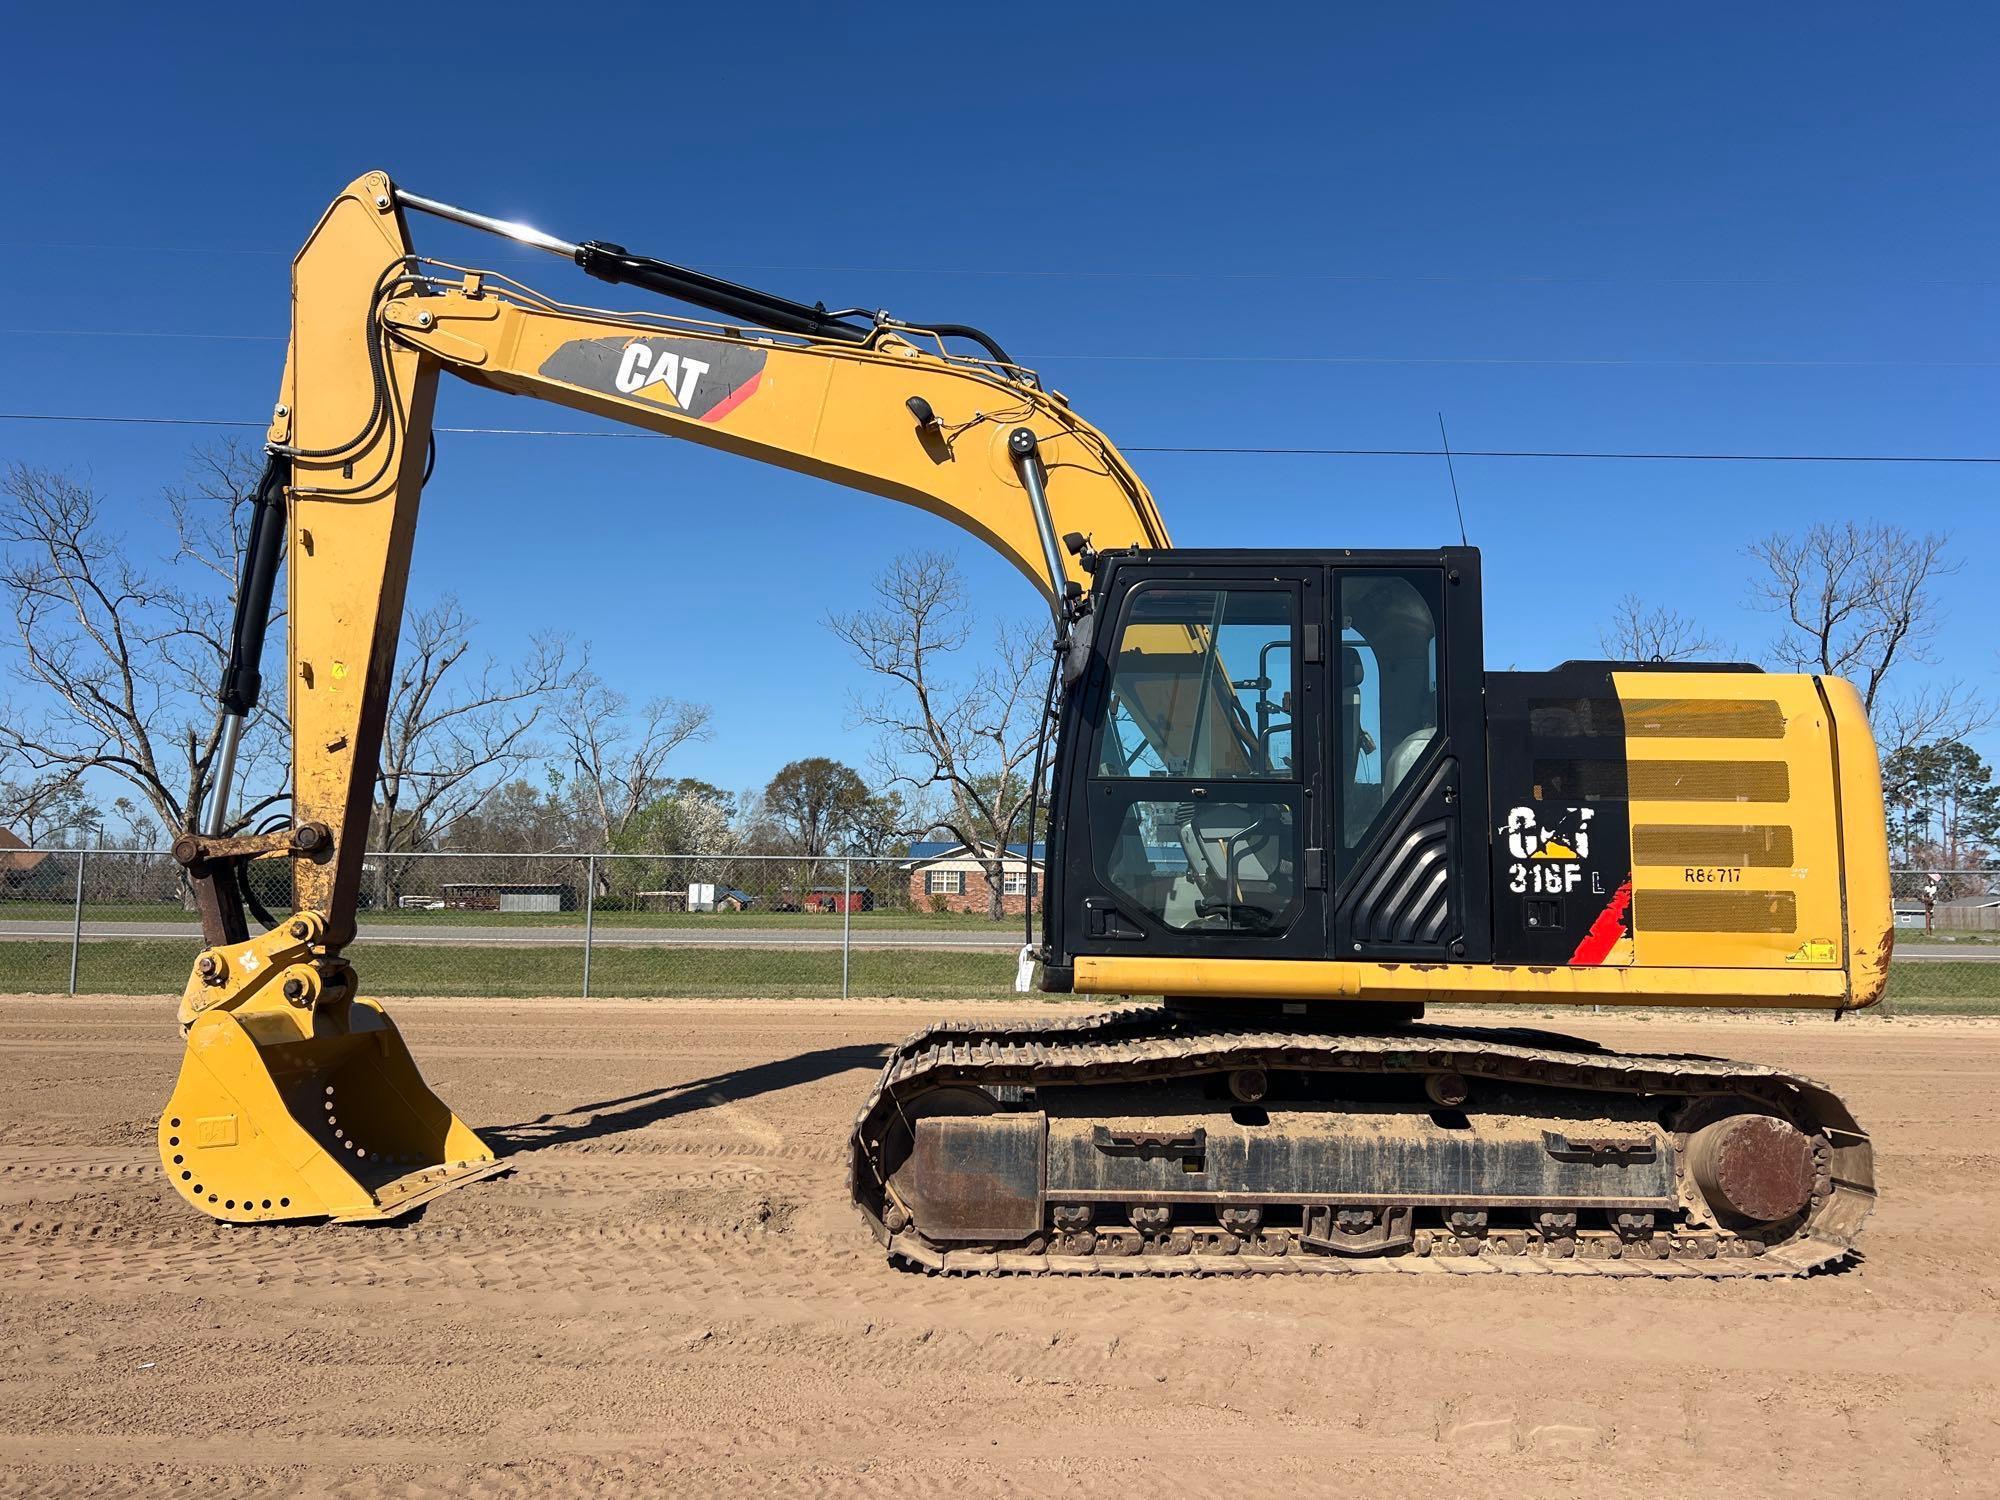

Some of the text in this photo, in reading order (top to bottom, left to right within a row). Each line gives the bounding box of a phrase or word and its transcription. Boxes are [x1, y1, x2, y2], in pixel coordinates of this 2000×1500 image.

[615, 343, 710, 410] CAT
[1509, 863, 1606, 894] 316F L
[1685, 868, 1741, 882] R86717
